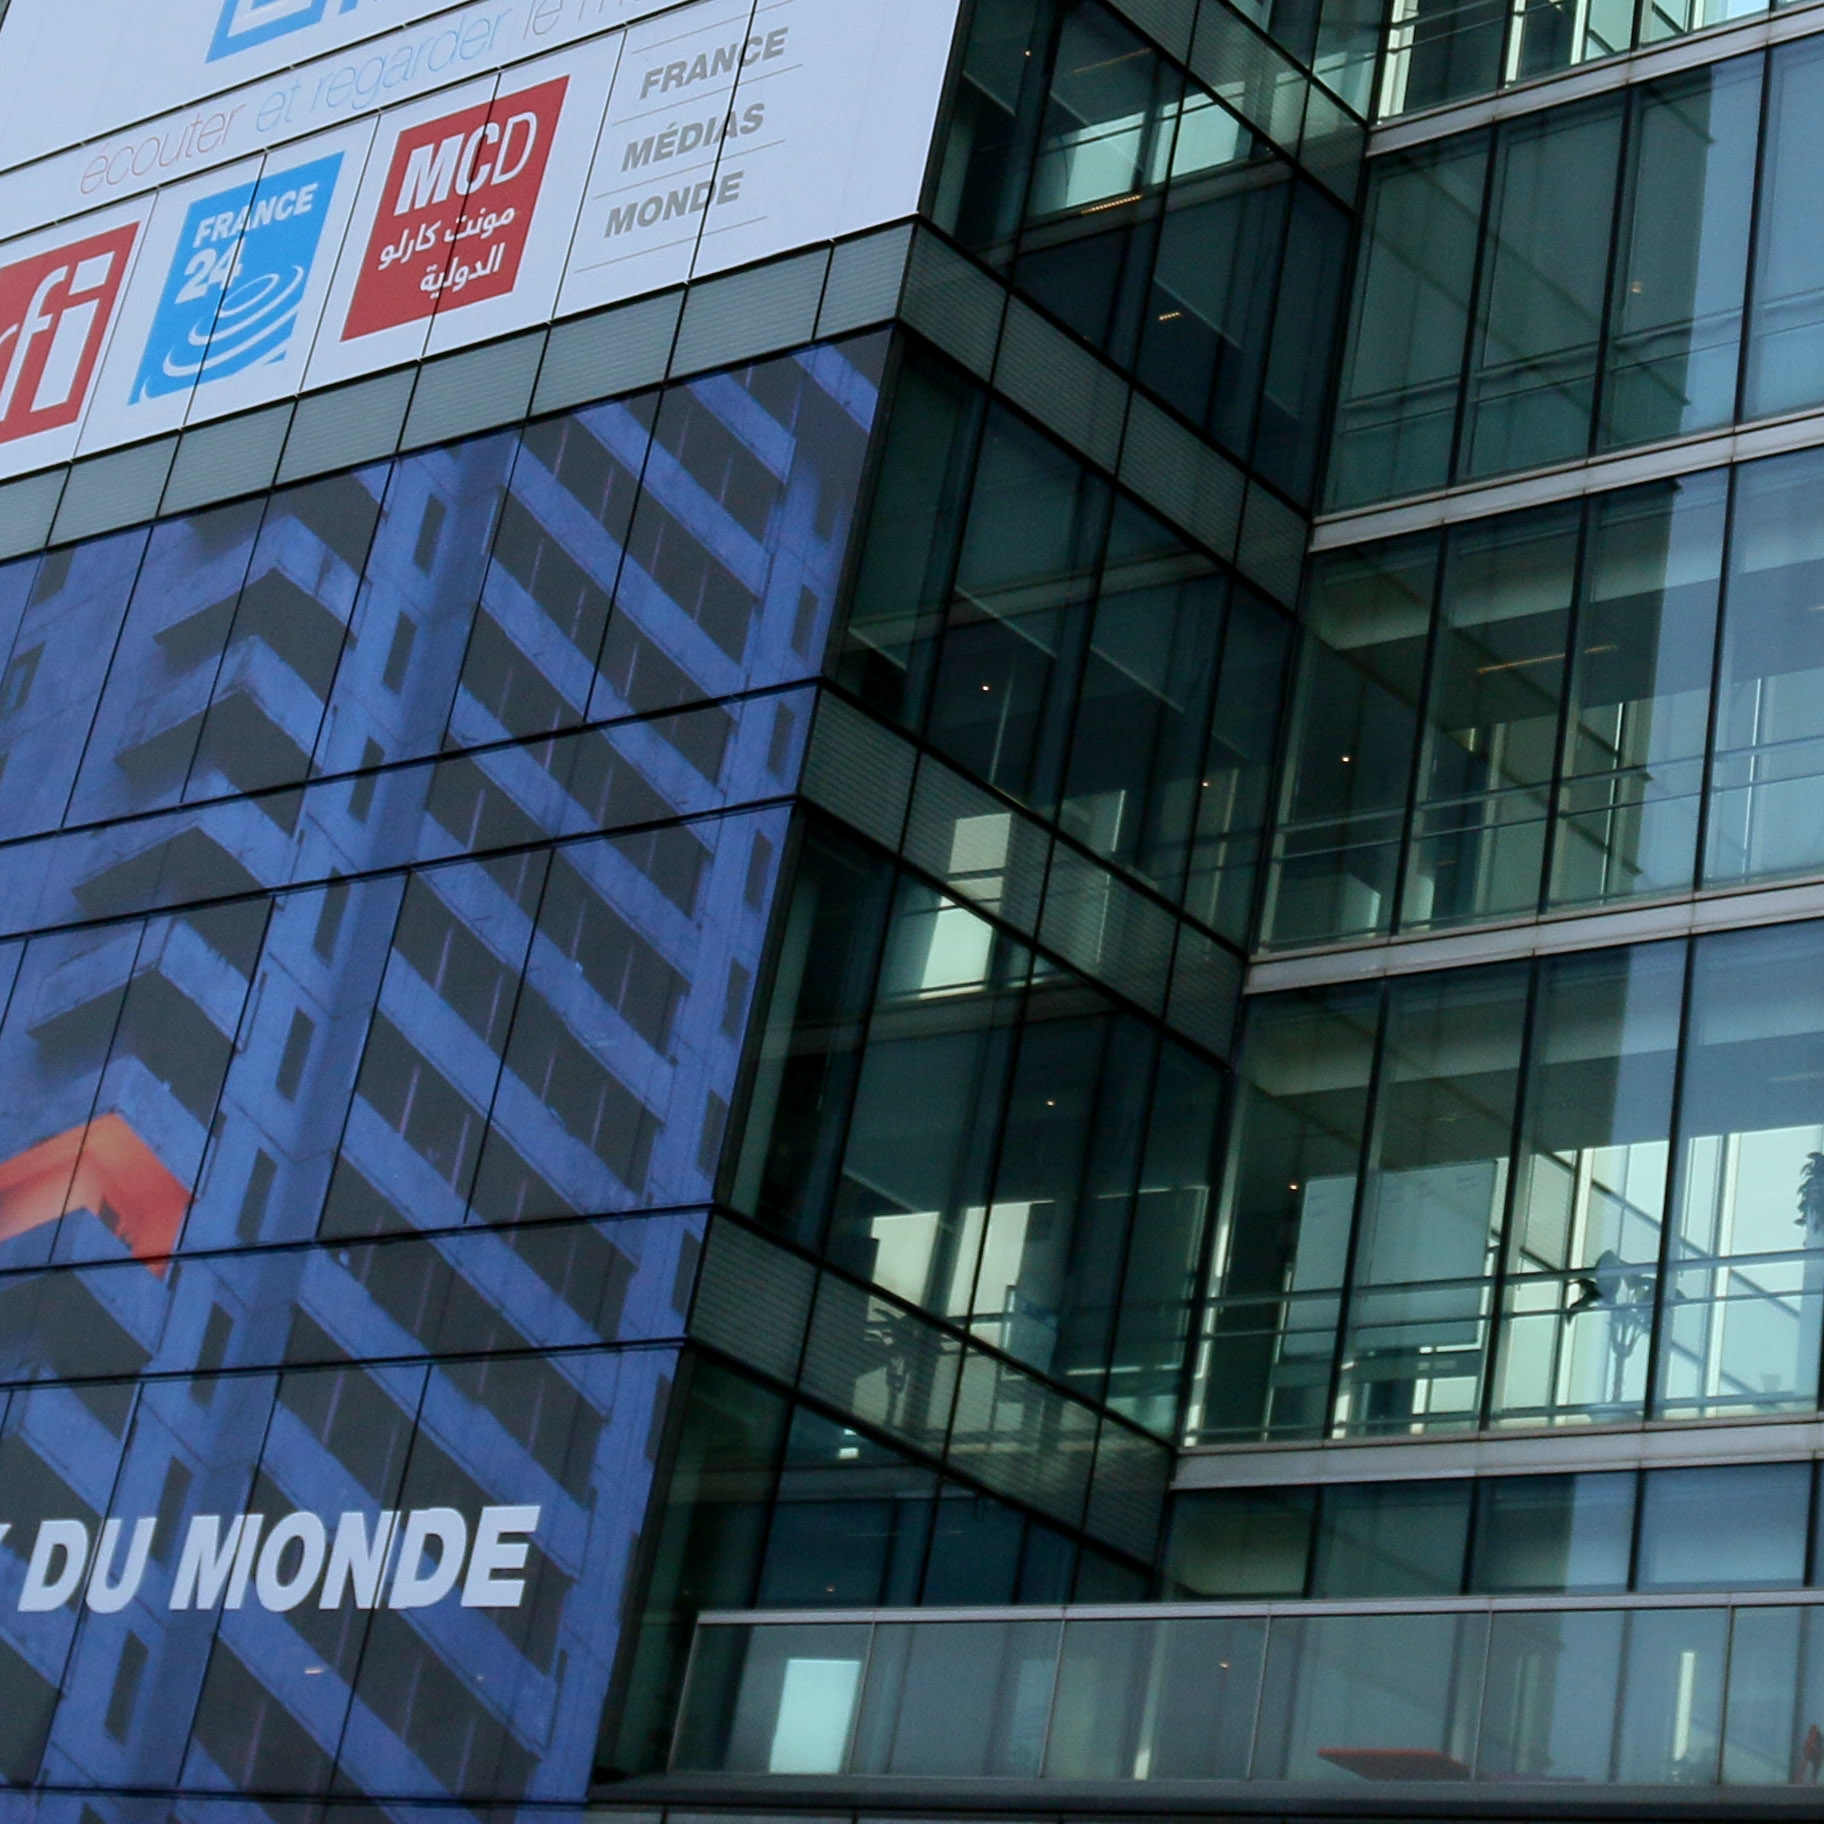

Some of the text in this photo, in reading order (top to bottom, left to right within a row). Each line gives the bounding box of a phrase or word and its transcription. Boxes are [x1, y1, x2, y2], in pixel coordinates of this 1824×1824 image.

[639, 26, 789, 100] FRANCE
[80, 103, 246, 195] écouter
[256, 74, 303, 133] et
[312, 6, 513, 114] regarder
[393, 111, 538, 216] MCD
[620, 102, 766, 172] MÉDIAS
[192, 182, 318, 249] FRANCE
[378, 207, 516, 271] مونت كارلو
[604, 170, 745, 239] MONDE
[173, 238, 243, 305] 24
[420, 242, 506, 300] الدولية
[17, 1517, 157, 1614] DU
[168, 1505, 542, 1612] MONDE
